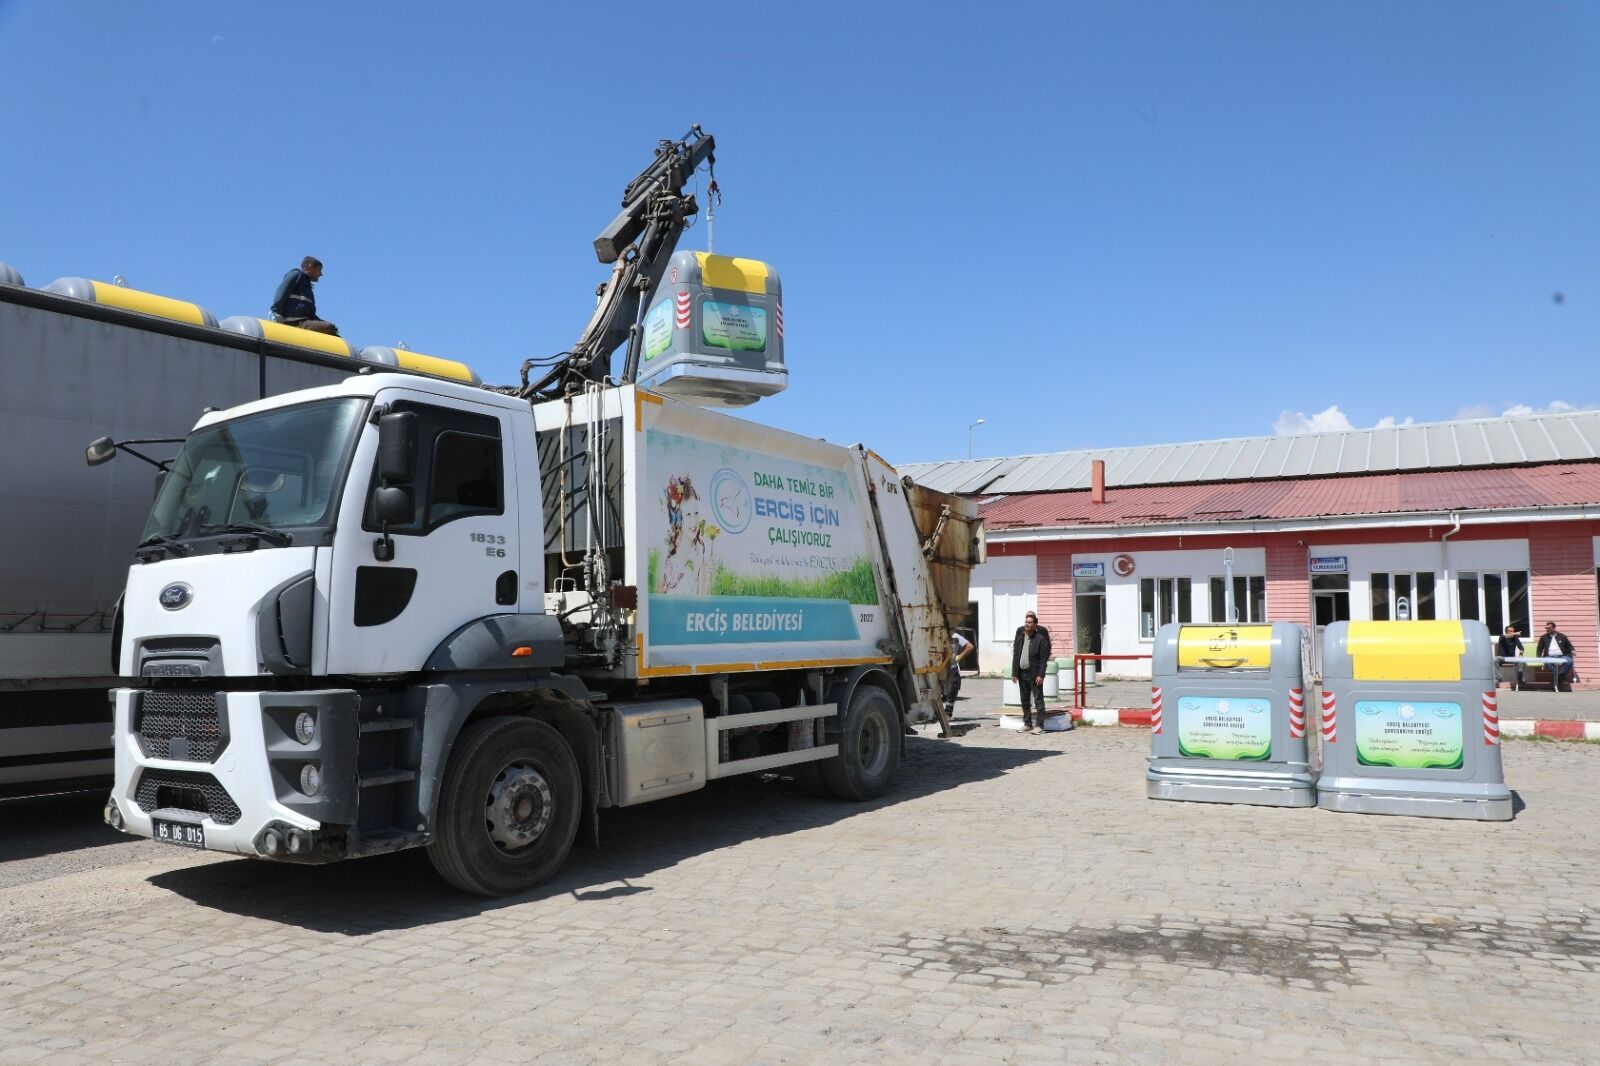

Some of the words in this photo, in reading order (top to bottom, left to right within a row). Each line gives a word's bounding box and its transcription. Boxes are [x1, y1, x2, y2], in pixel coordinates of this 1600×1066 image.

[754, 472, 784, 490] DAHA
[787, 478, 816, 496] TEMİZ
[819, 482, 834, 499] BİR
[755, 497, 805, 526] ERCİŞ
[809, 502, 839, 528] İÇİN
[470, 532, 506, 545] 1833
[768, 527, 831, 548] ÇALIŞIYORUZ
[486, 547, 506, 557] E6
[686, 608, 727, 636] ERCİŞ
[733, 609, 803, 632] BELEDİYESİ
[860, 613, 874, 623] 2022
[160, 823, 168, 838] 65
[187, 827, 202, 842] 015
